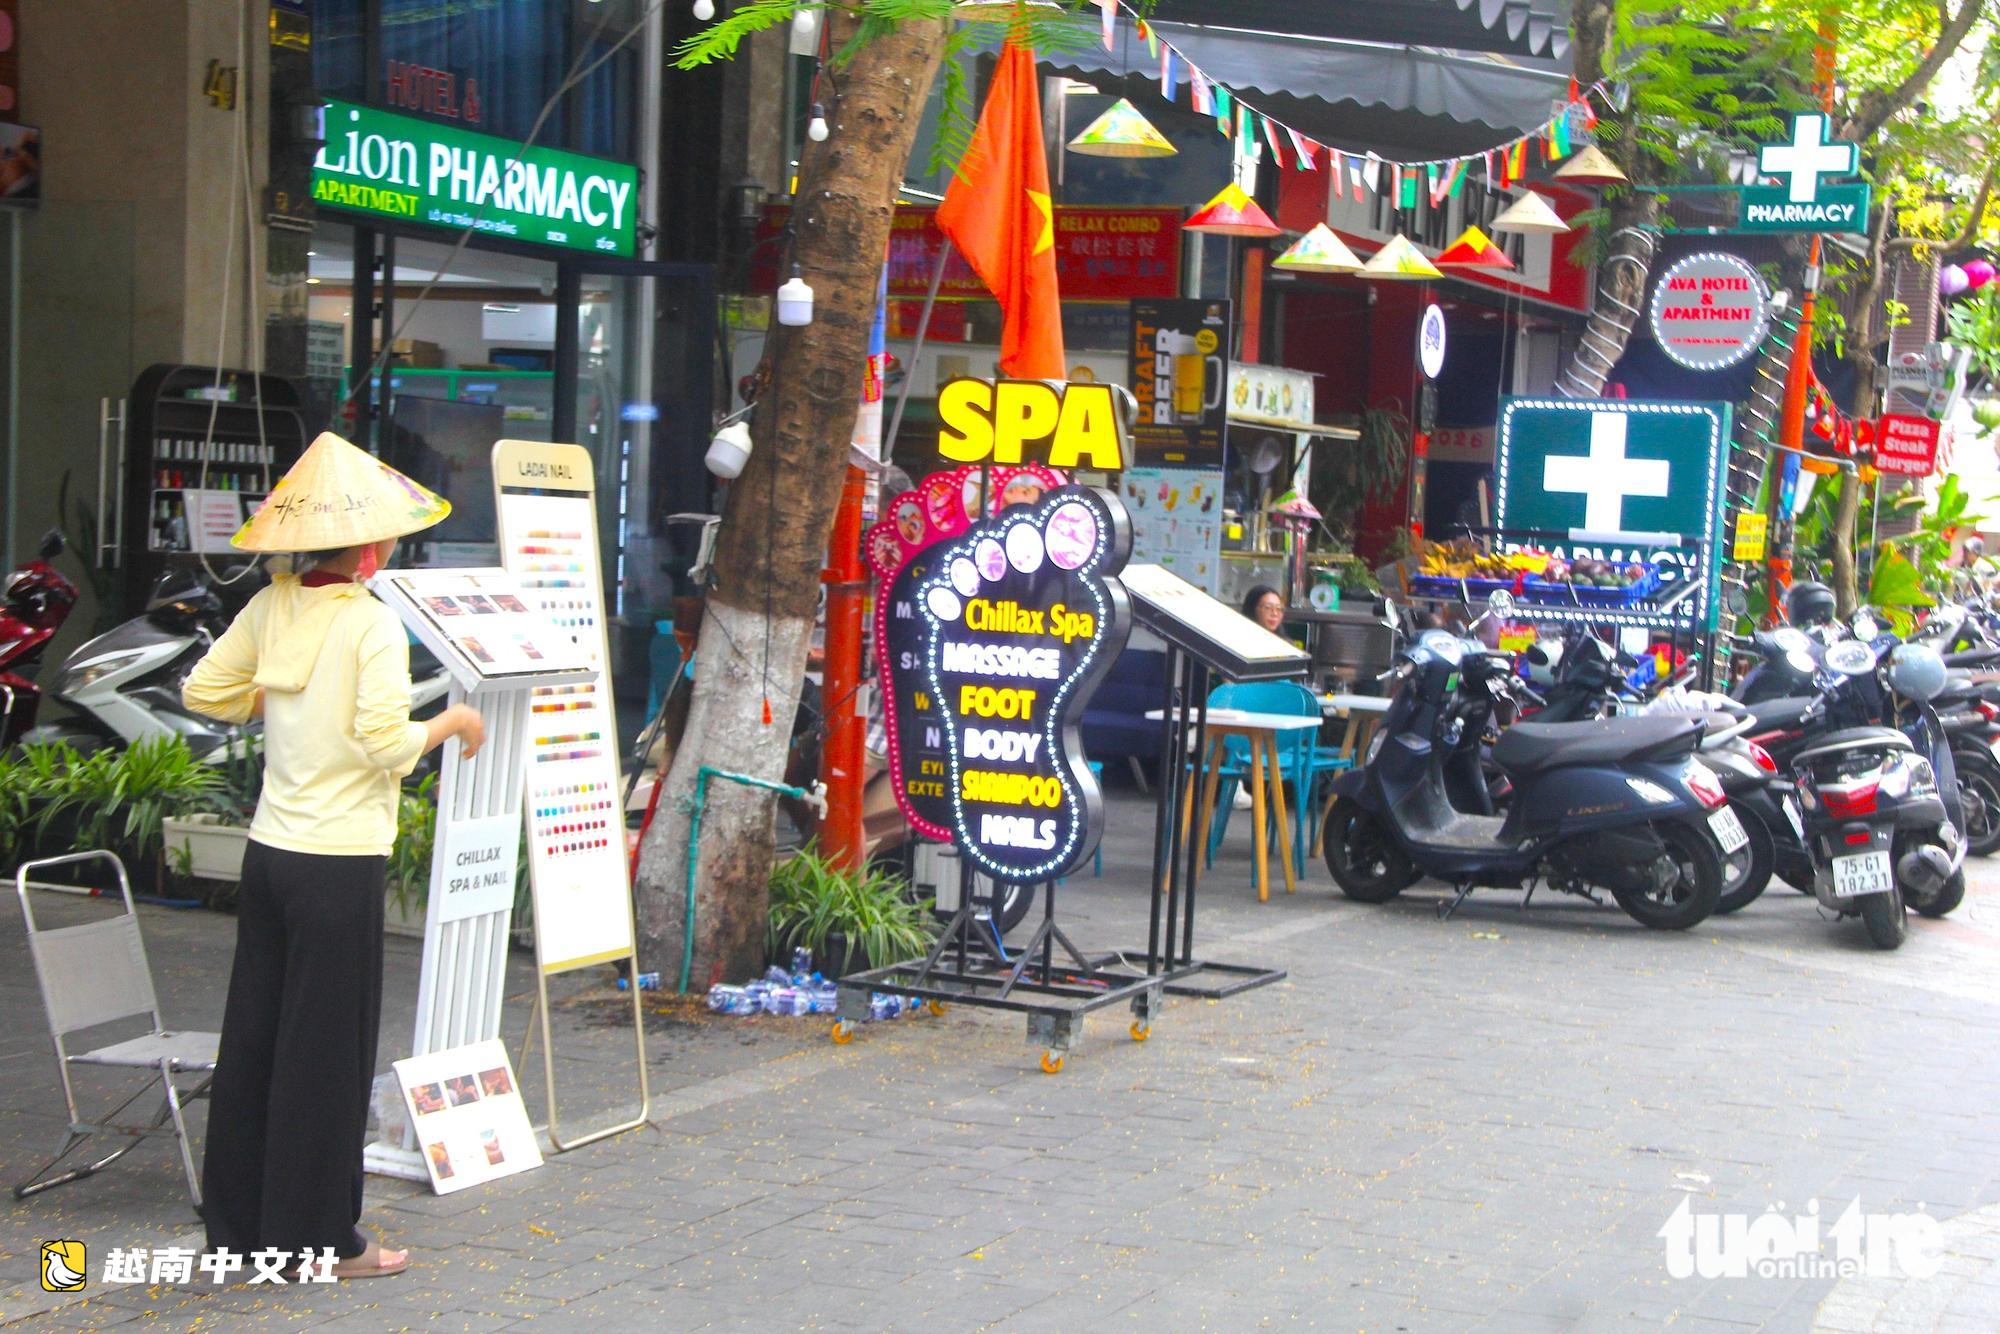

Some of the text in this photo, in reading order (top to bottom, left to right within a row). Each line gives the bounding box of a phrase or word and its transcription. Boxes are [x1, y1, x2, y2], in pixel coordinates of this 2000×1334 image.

[387, 59, 459, 118] HOTEL
[313, 102, 631, 230] Lion PHARMACY
[313, 178, 420, 217] APARTMENT
[1747, 204, 1855, 223] PHARMACY
[1060, 216, 1161, 233] RELAX COMBO
[1668, 277, 1749, 291] AVA HOTEL
[1700, 292, 1713, 306] &
[1663, 306, 1751, 320] APARTMENT
[1135, 320, 1157, 424] DRAFT
[1154, 328, 1176, 425] BEER
[938, 379, 1122, 470] SPA
[1876, 454, 1931, 475] Burger
[965, 598, 1094, 643] Chillax Spa
[942, 642, 1060, 680] MASSAGE
[960, 686, 1036, 720] FOOT
[963, 728, 1042, 763] BODY
[961, 770, 1061, 808] SHAMPOO
[981, 813, 1057, 850] NAILS
[456, 845, 502, 866] CHILLAX
[449, 877, 470, 893] SPA
[483, 870, 509, 887] NAIL
